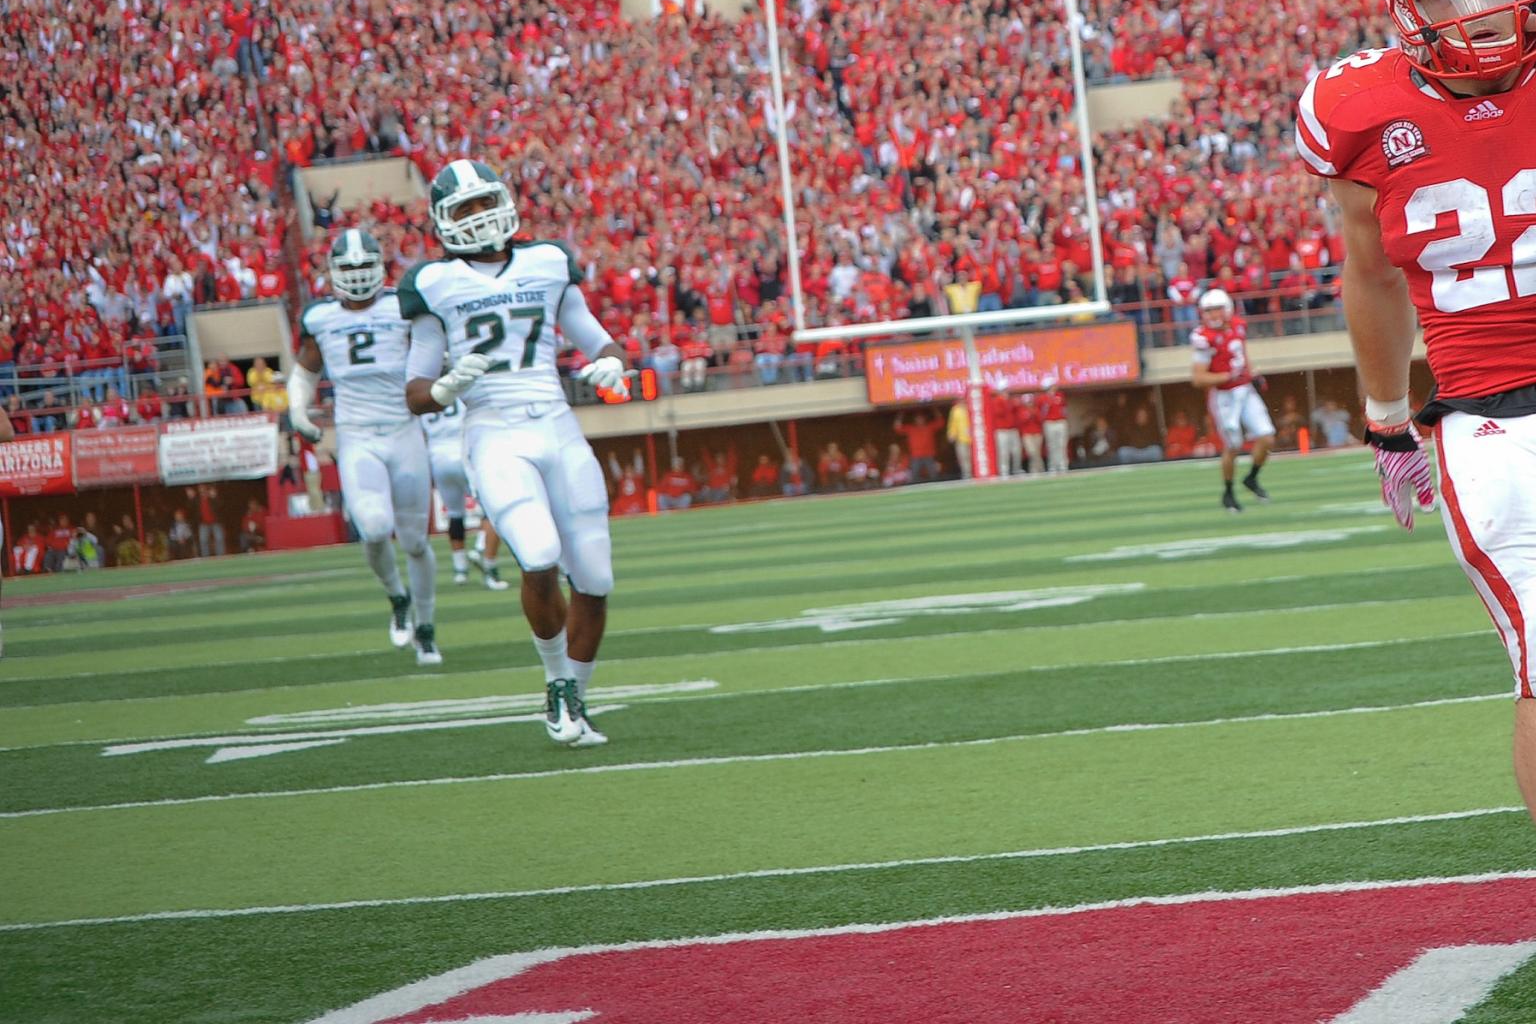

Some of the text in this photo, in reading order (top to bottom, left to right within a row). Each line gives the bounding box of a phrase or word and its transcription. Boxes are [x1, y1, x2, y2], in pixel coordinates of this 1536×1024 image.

[1463, 109, 1504, 122] adidas
[1391, 131, 1412, 153] N
[456, 290, 547, 316] MICHIGAN STATE
[349, 331, 377, 366] 2
[464, 307, 546, 373] 27
[1064, 361, 1130, 382] Center
[1473, 429, 1506, 438] adidas
